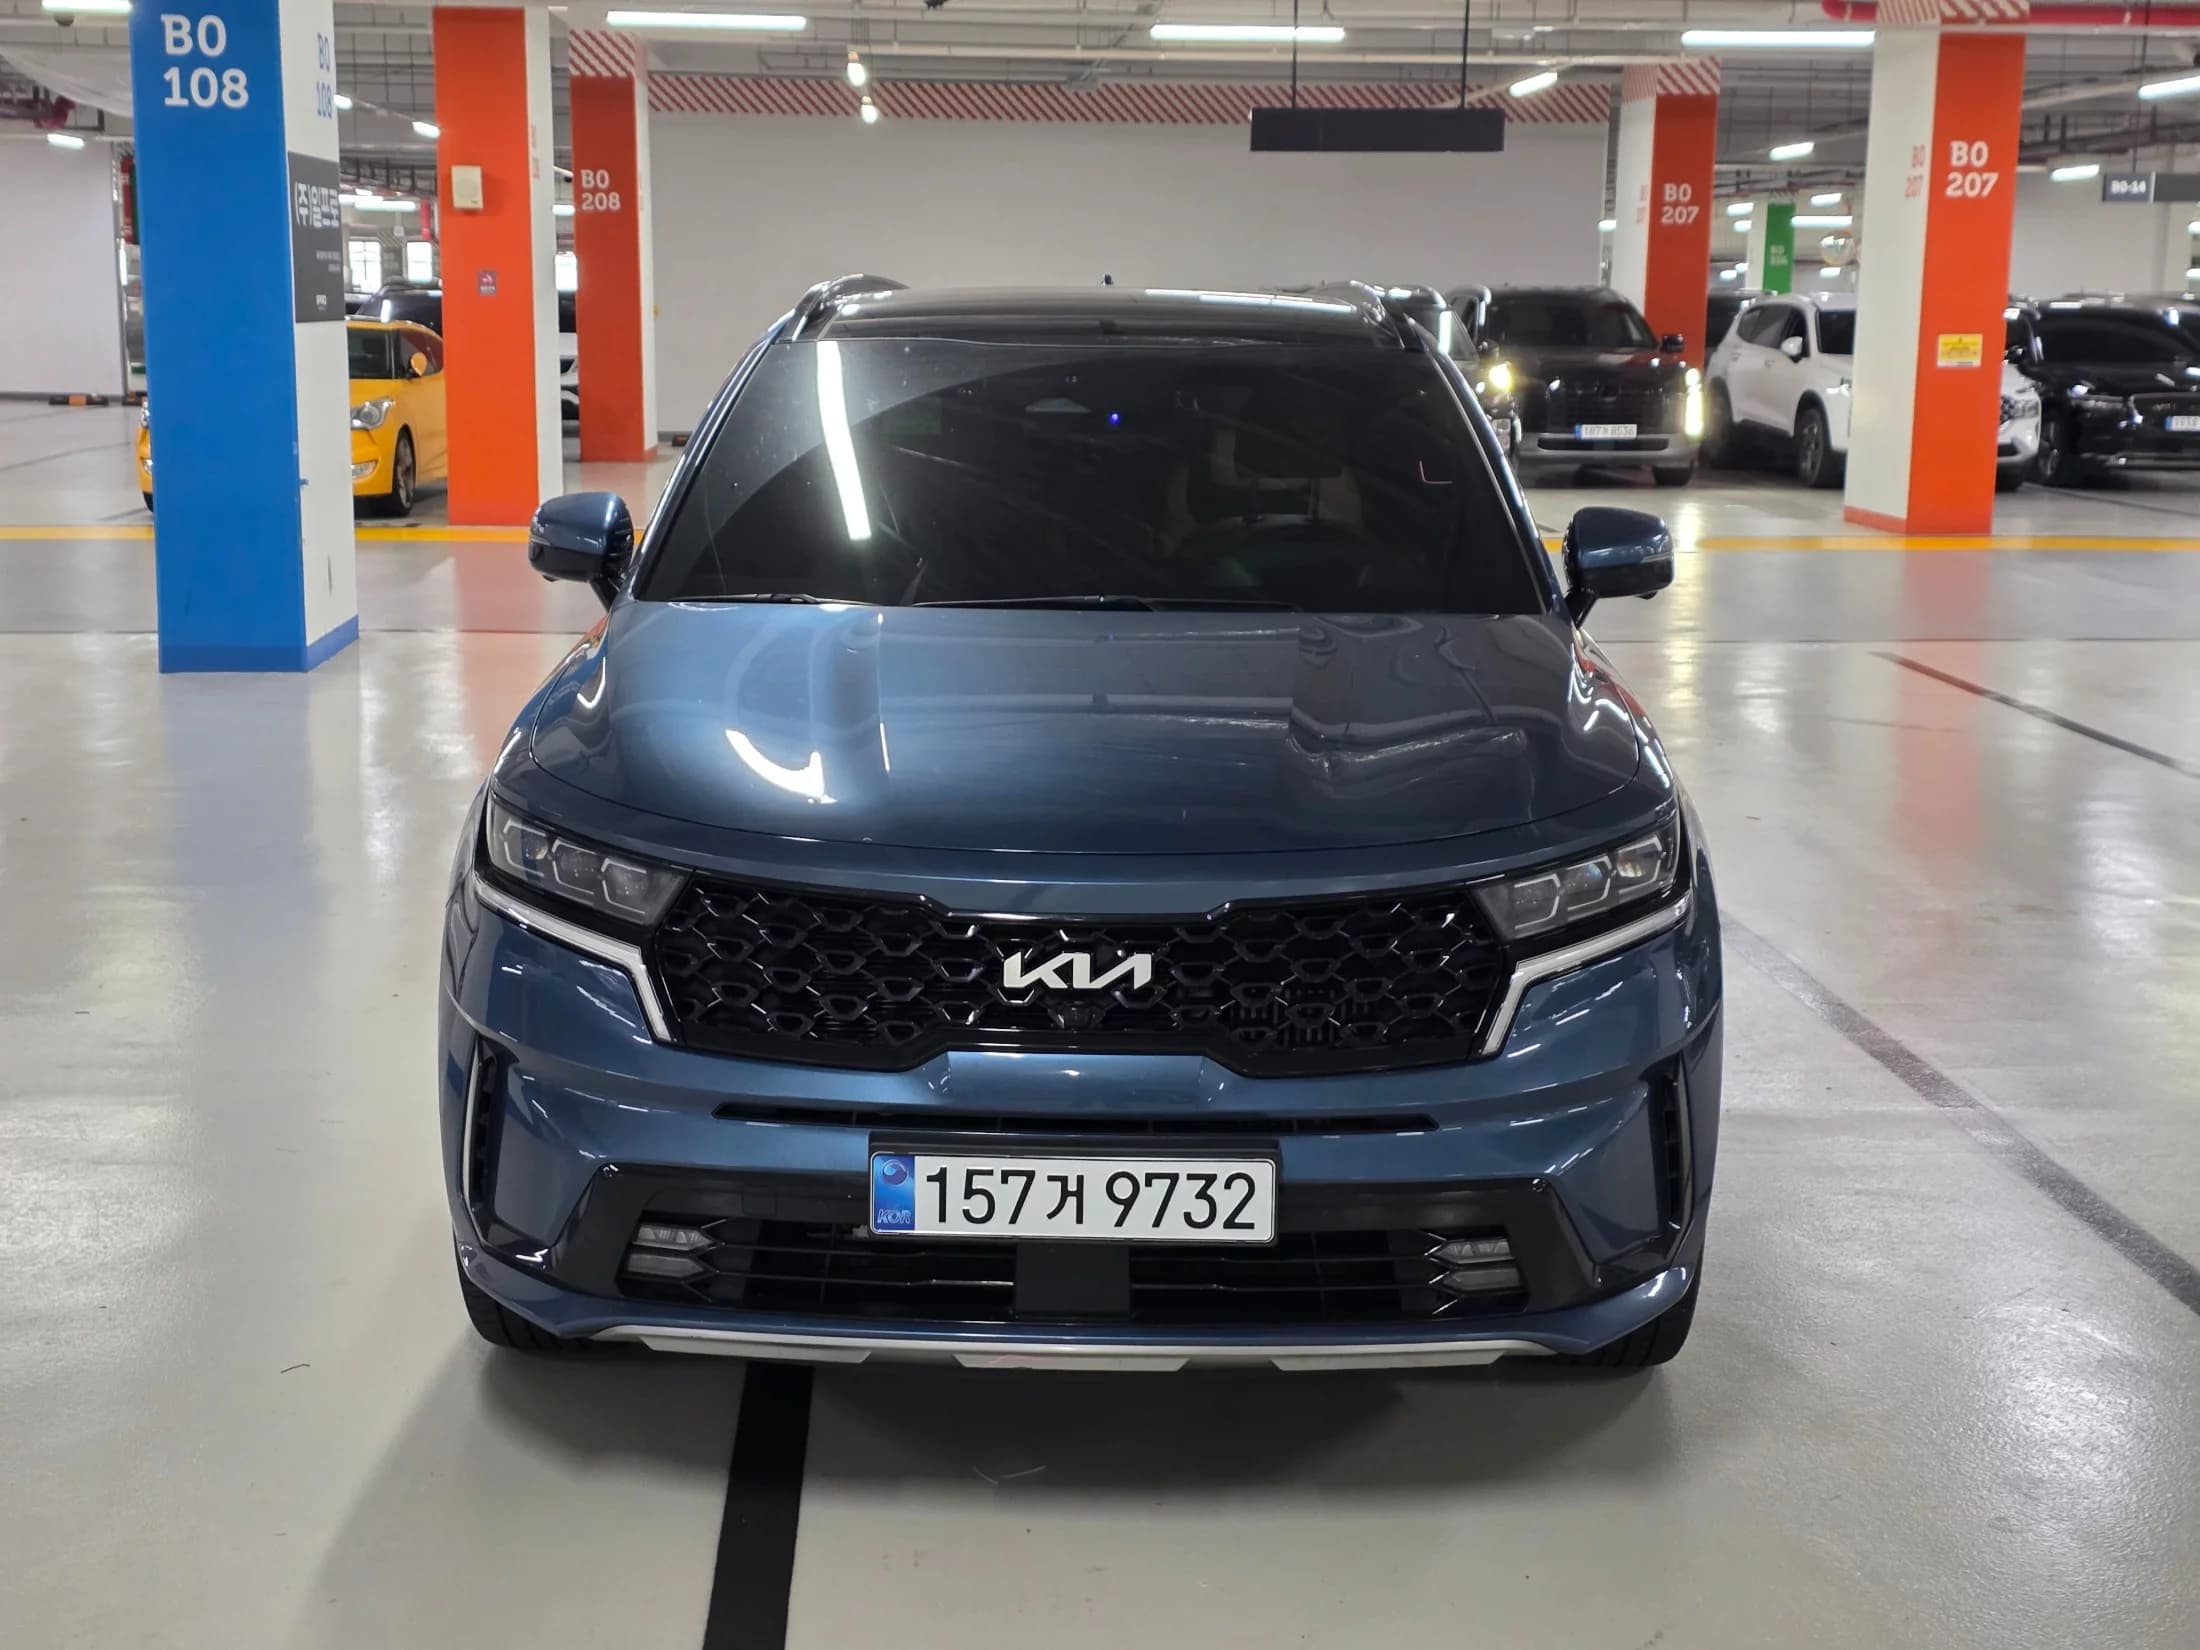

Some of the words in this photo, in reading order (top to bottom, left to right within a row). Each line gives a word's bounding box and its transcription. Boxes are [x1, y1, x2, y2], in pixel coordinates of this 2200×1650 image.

[163, 66, 249, 108] 108
[1944, 171, 1999, 198] 207
[581, 191, 622, 211] 208
[1661, 205, 1700, 225] 207
[1003, 951, 1152, 990] KIA
[926, 1166, 1085, 1226] 157거
[1105, 1170, 1257, 1230] 9732
[876, 1208, 913, 1225] KOR
